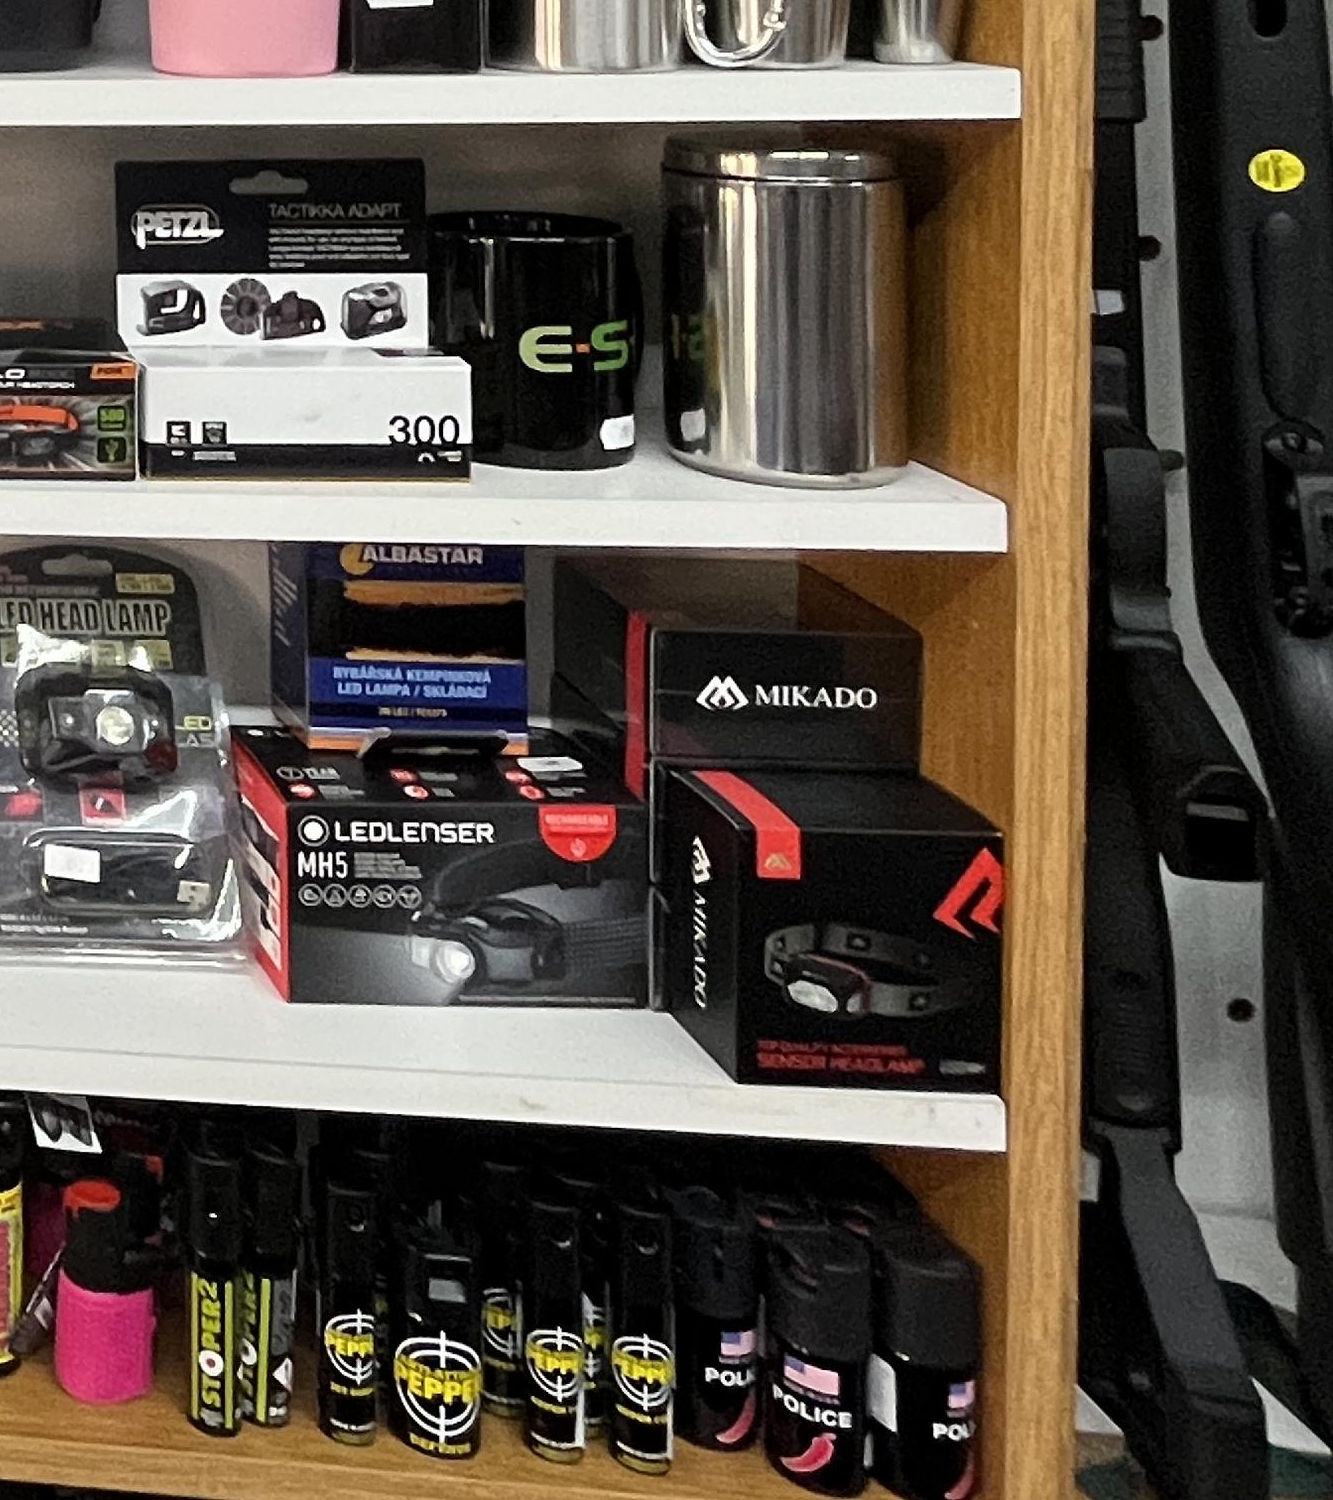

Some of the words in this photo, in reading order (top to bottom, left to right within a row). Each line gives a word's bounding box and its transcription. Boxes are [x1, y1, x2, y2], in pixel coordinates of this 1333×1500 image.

[268, 202, 346, 219] TACTIKKA
[347, 202, 403, 218] ADAPT
[135, 208, 225, 250] PETZL
[388, 414, 462, 446] 300
[361, 544, 484, 565] ALBASTAR
[38, 600, 101, 633] HEAD
[105, 600, 171, 634] LAMP
[754, 684, 879, 710] MIKADO
[333, 820, 495, 846] LEDLENSER
[296, 851, 349, 880] MH5
[693, 890, 709, 1010] MIKADO
[772, 1381, 854, 1430] POLICE
